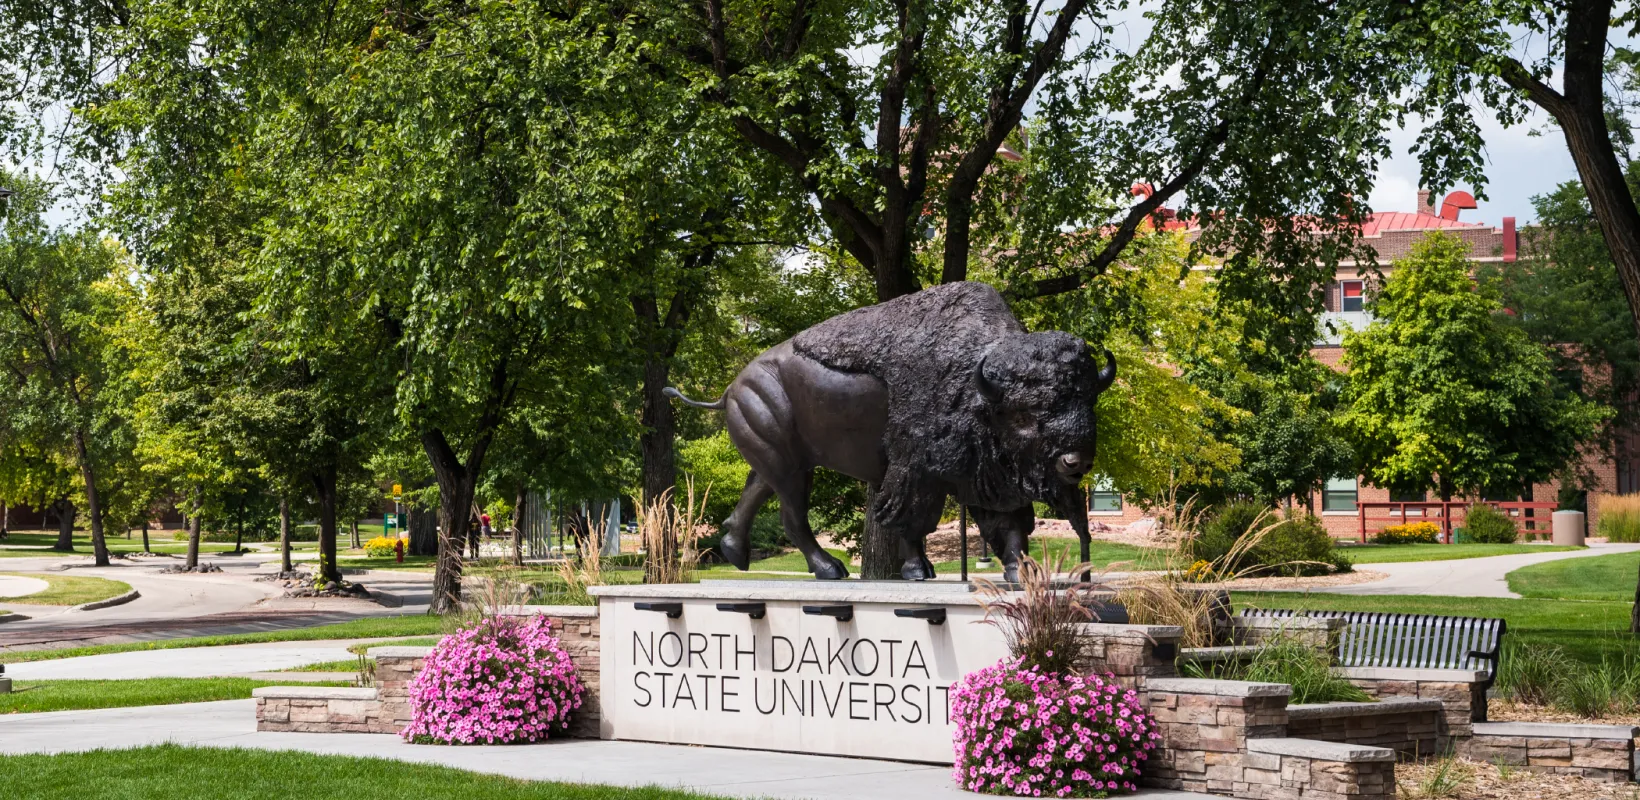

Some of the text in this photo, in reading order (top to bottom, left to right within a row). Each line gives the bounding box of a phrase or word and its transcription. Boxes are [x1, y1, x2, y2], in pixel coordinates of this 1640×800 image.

[633, 630, 930, 679] NORTH DAKOTA
[633, 671, 950, 725] STATE UNIVERSIT
